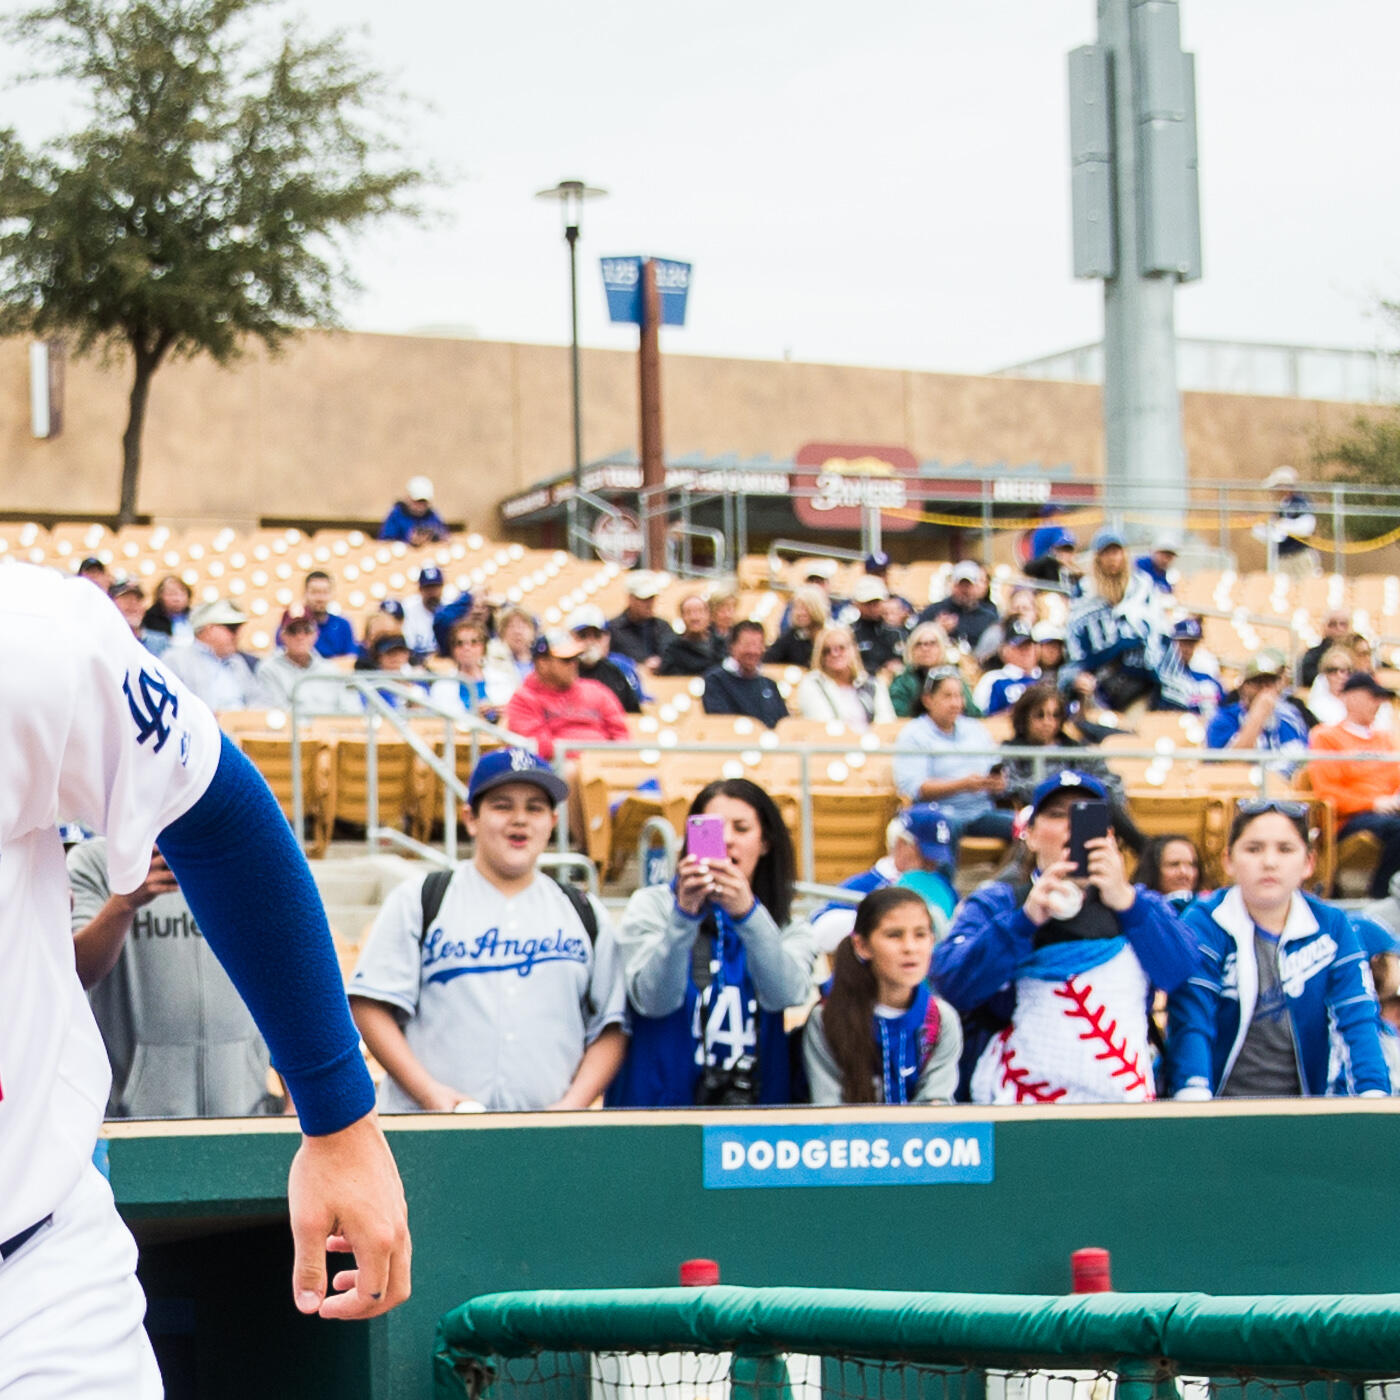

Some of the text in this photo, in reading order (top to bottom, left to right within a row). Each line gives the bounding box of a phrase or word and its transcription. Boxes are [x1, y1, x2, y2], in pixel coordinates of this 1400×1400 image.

[132, 911, 202, 940] Hurle
[423, 927, 466, 966] Los
[721, 1137, 981, 1171] DODGERS.COM
